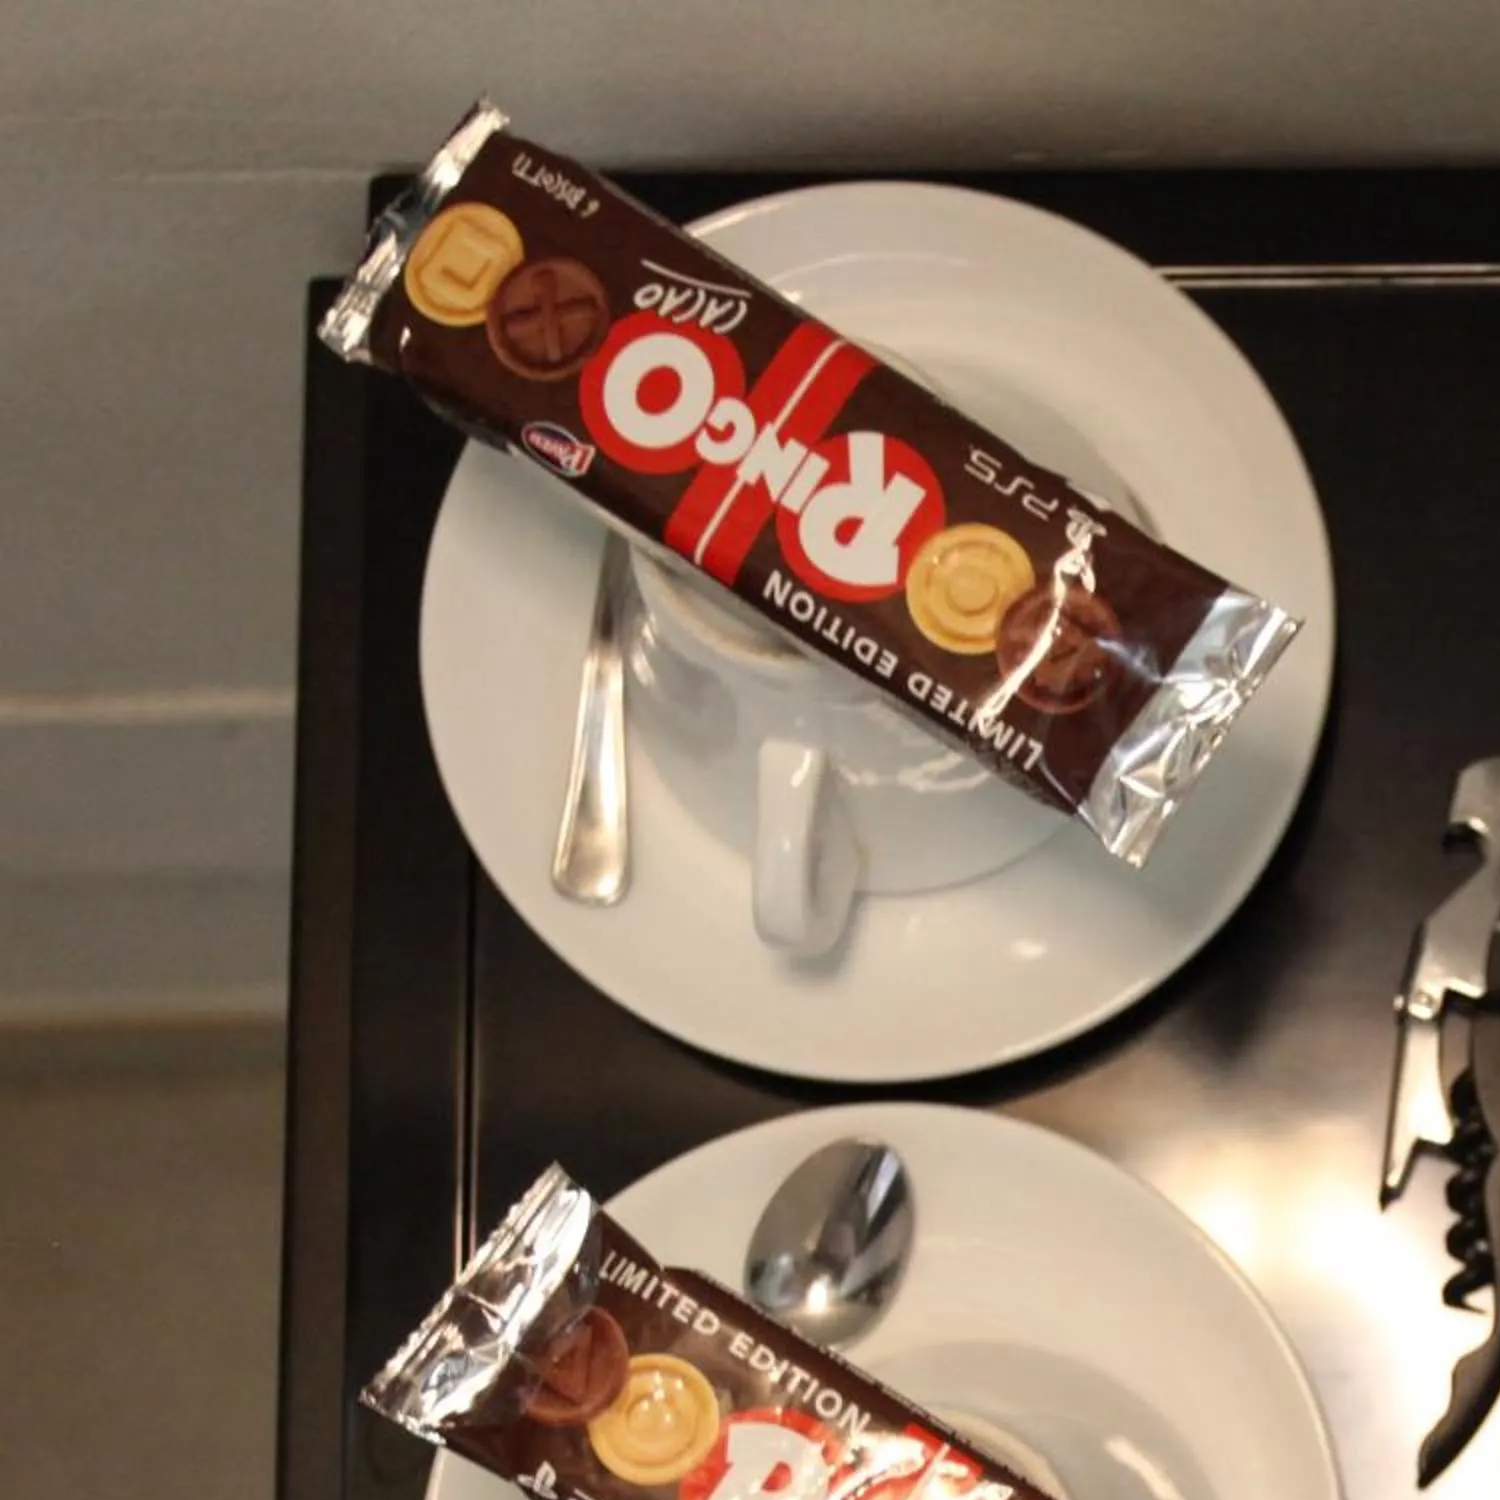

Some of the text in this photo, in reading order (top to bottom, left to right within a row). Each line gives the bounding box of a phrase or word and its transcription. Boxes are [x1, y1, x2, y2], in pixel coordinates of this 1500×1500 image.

[632, 282, 748, 335] CACAO
[603, 331, 926, 587] RINGO
[964, 447, 1059, 522] PS5
[763, 569, 899, 679] EDITION
[599, 1250, 873, 1436] LIMITED EDITION
